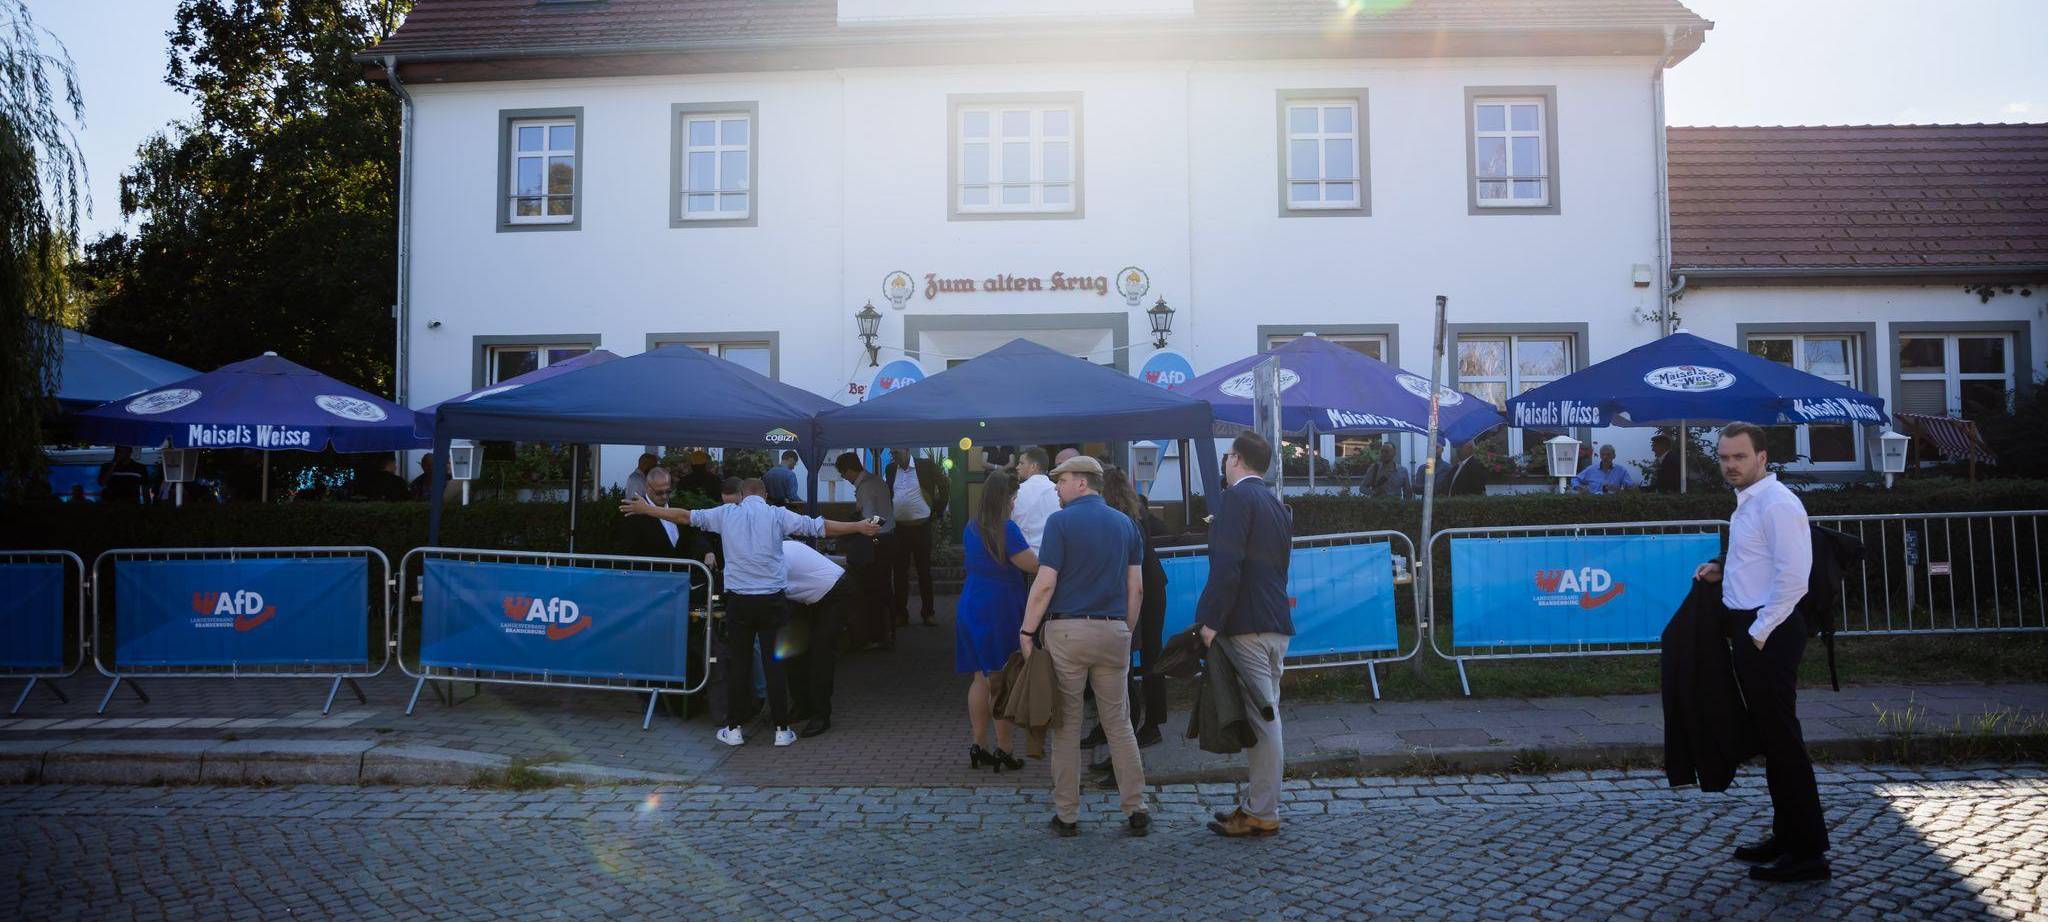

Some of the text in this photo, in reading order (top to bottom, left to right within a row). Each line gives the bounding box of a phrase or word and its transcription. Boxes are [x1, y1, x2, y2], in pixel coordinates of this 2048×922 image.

[924, 271, 1108, 300] Zum alten Krug
[1158, 370, 1186, 384] AfD
[1514, 400, 1600, 427] Maisel's Weisse
[188, 424, 311, 447] Maisel's Weisse
[765, 434, 795, 442] COBIZI
[1558, 566, 1612, 593] AfD
[214, 589, 264, 615] AfD
[525, 597, 580, 624] AfD
